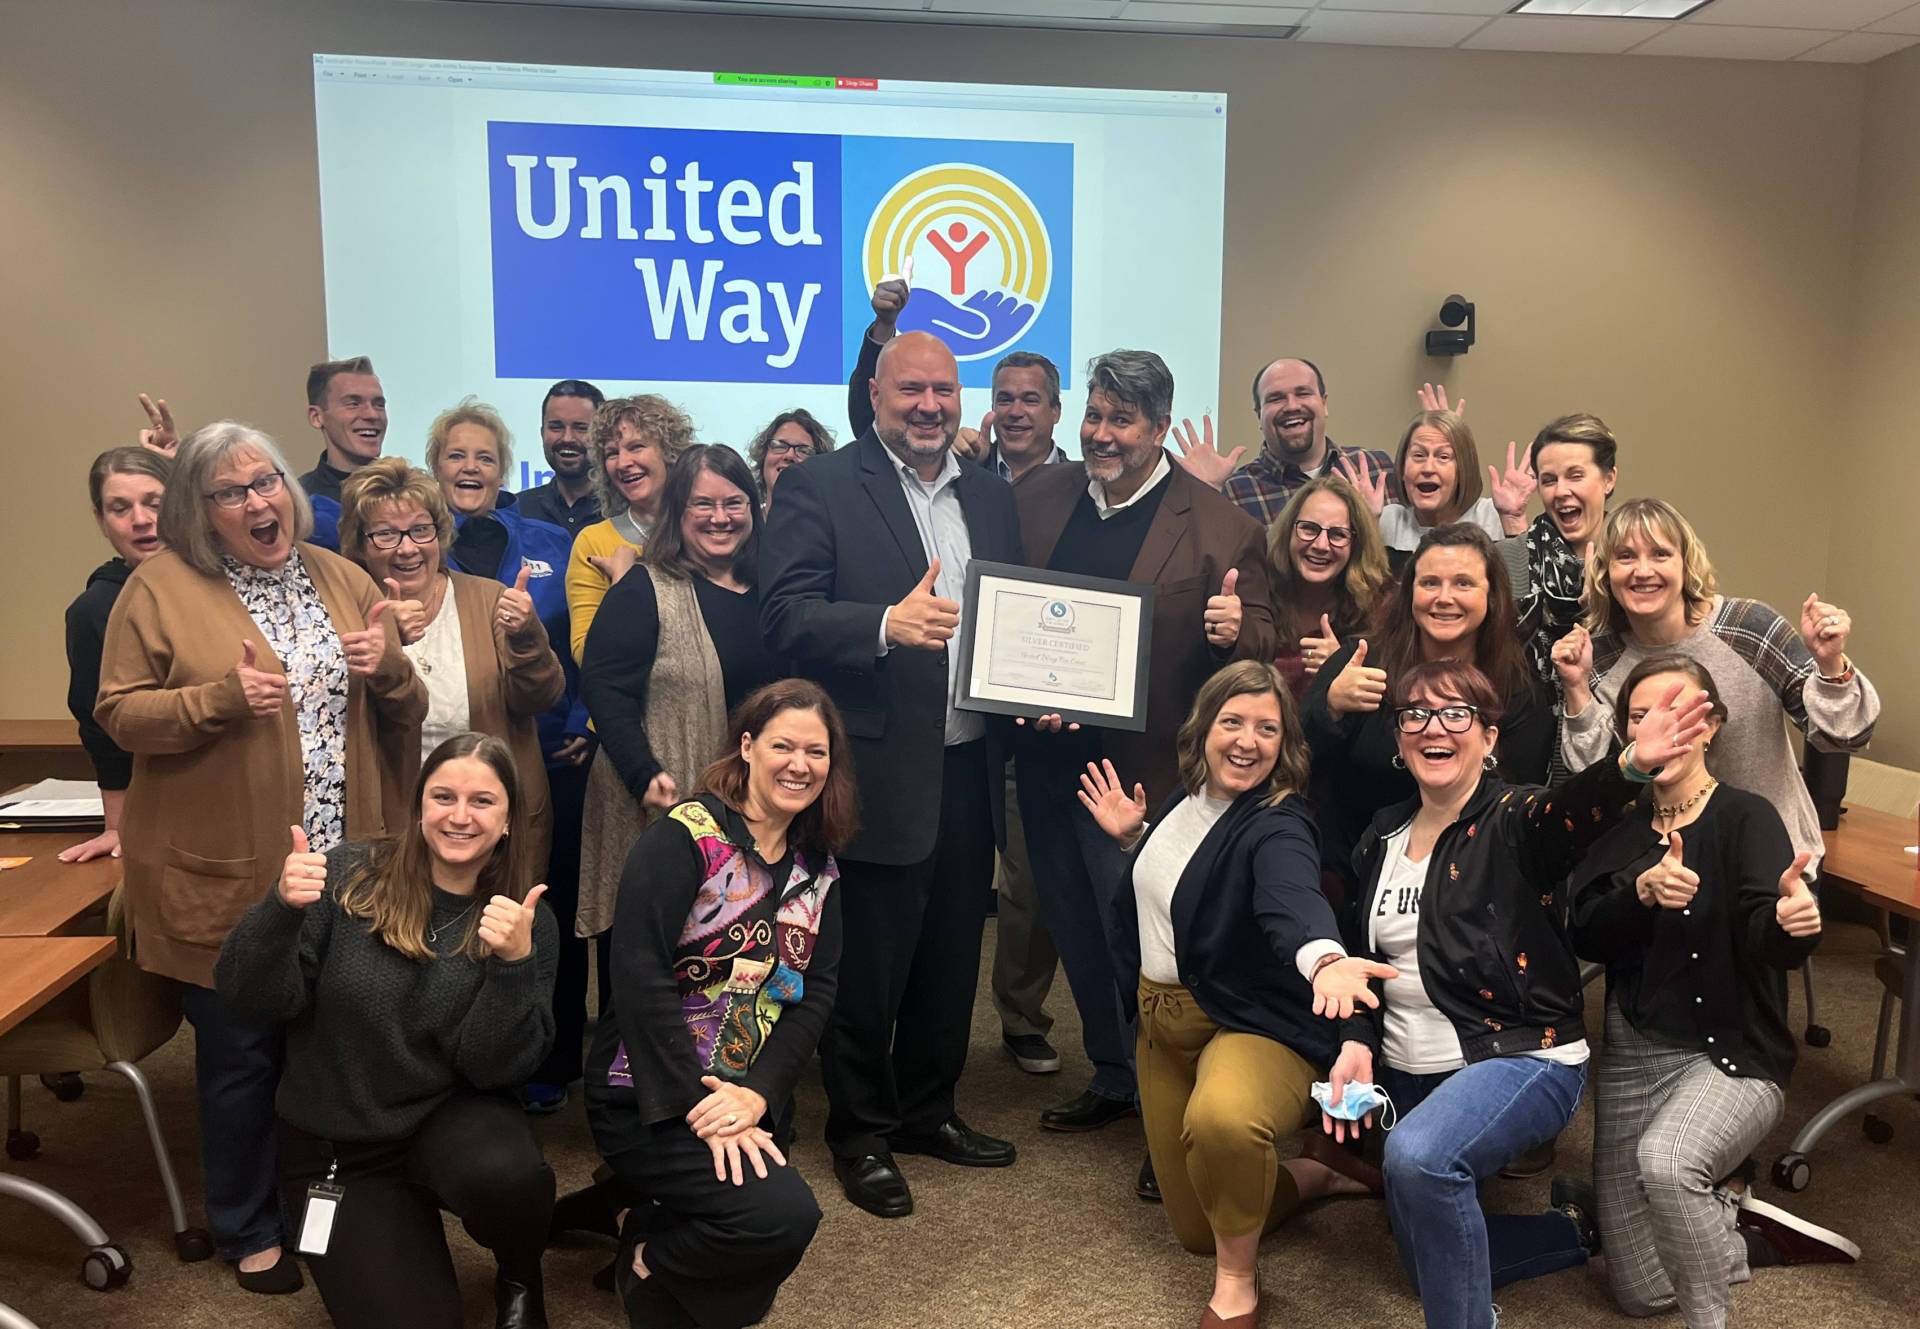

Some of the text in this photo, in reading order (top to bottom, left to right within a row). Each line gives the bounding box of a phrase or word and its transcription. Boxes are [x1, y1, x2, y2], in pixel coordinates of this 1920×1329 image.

[506, 154, 823, 246] United
[633, 257, 822, 369] Way
[1021, 635, 1048, 645] SILVER
[1050, 639, 1090, 651] CERTIFIED
